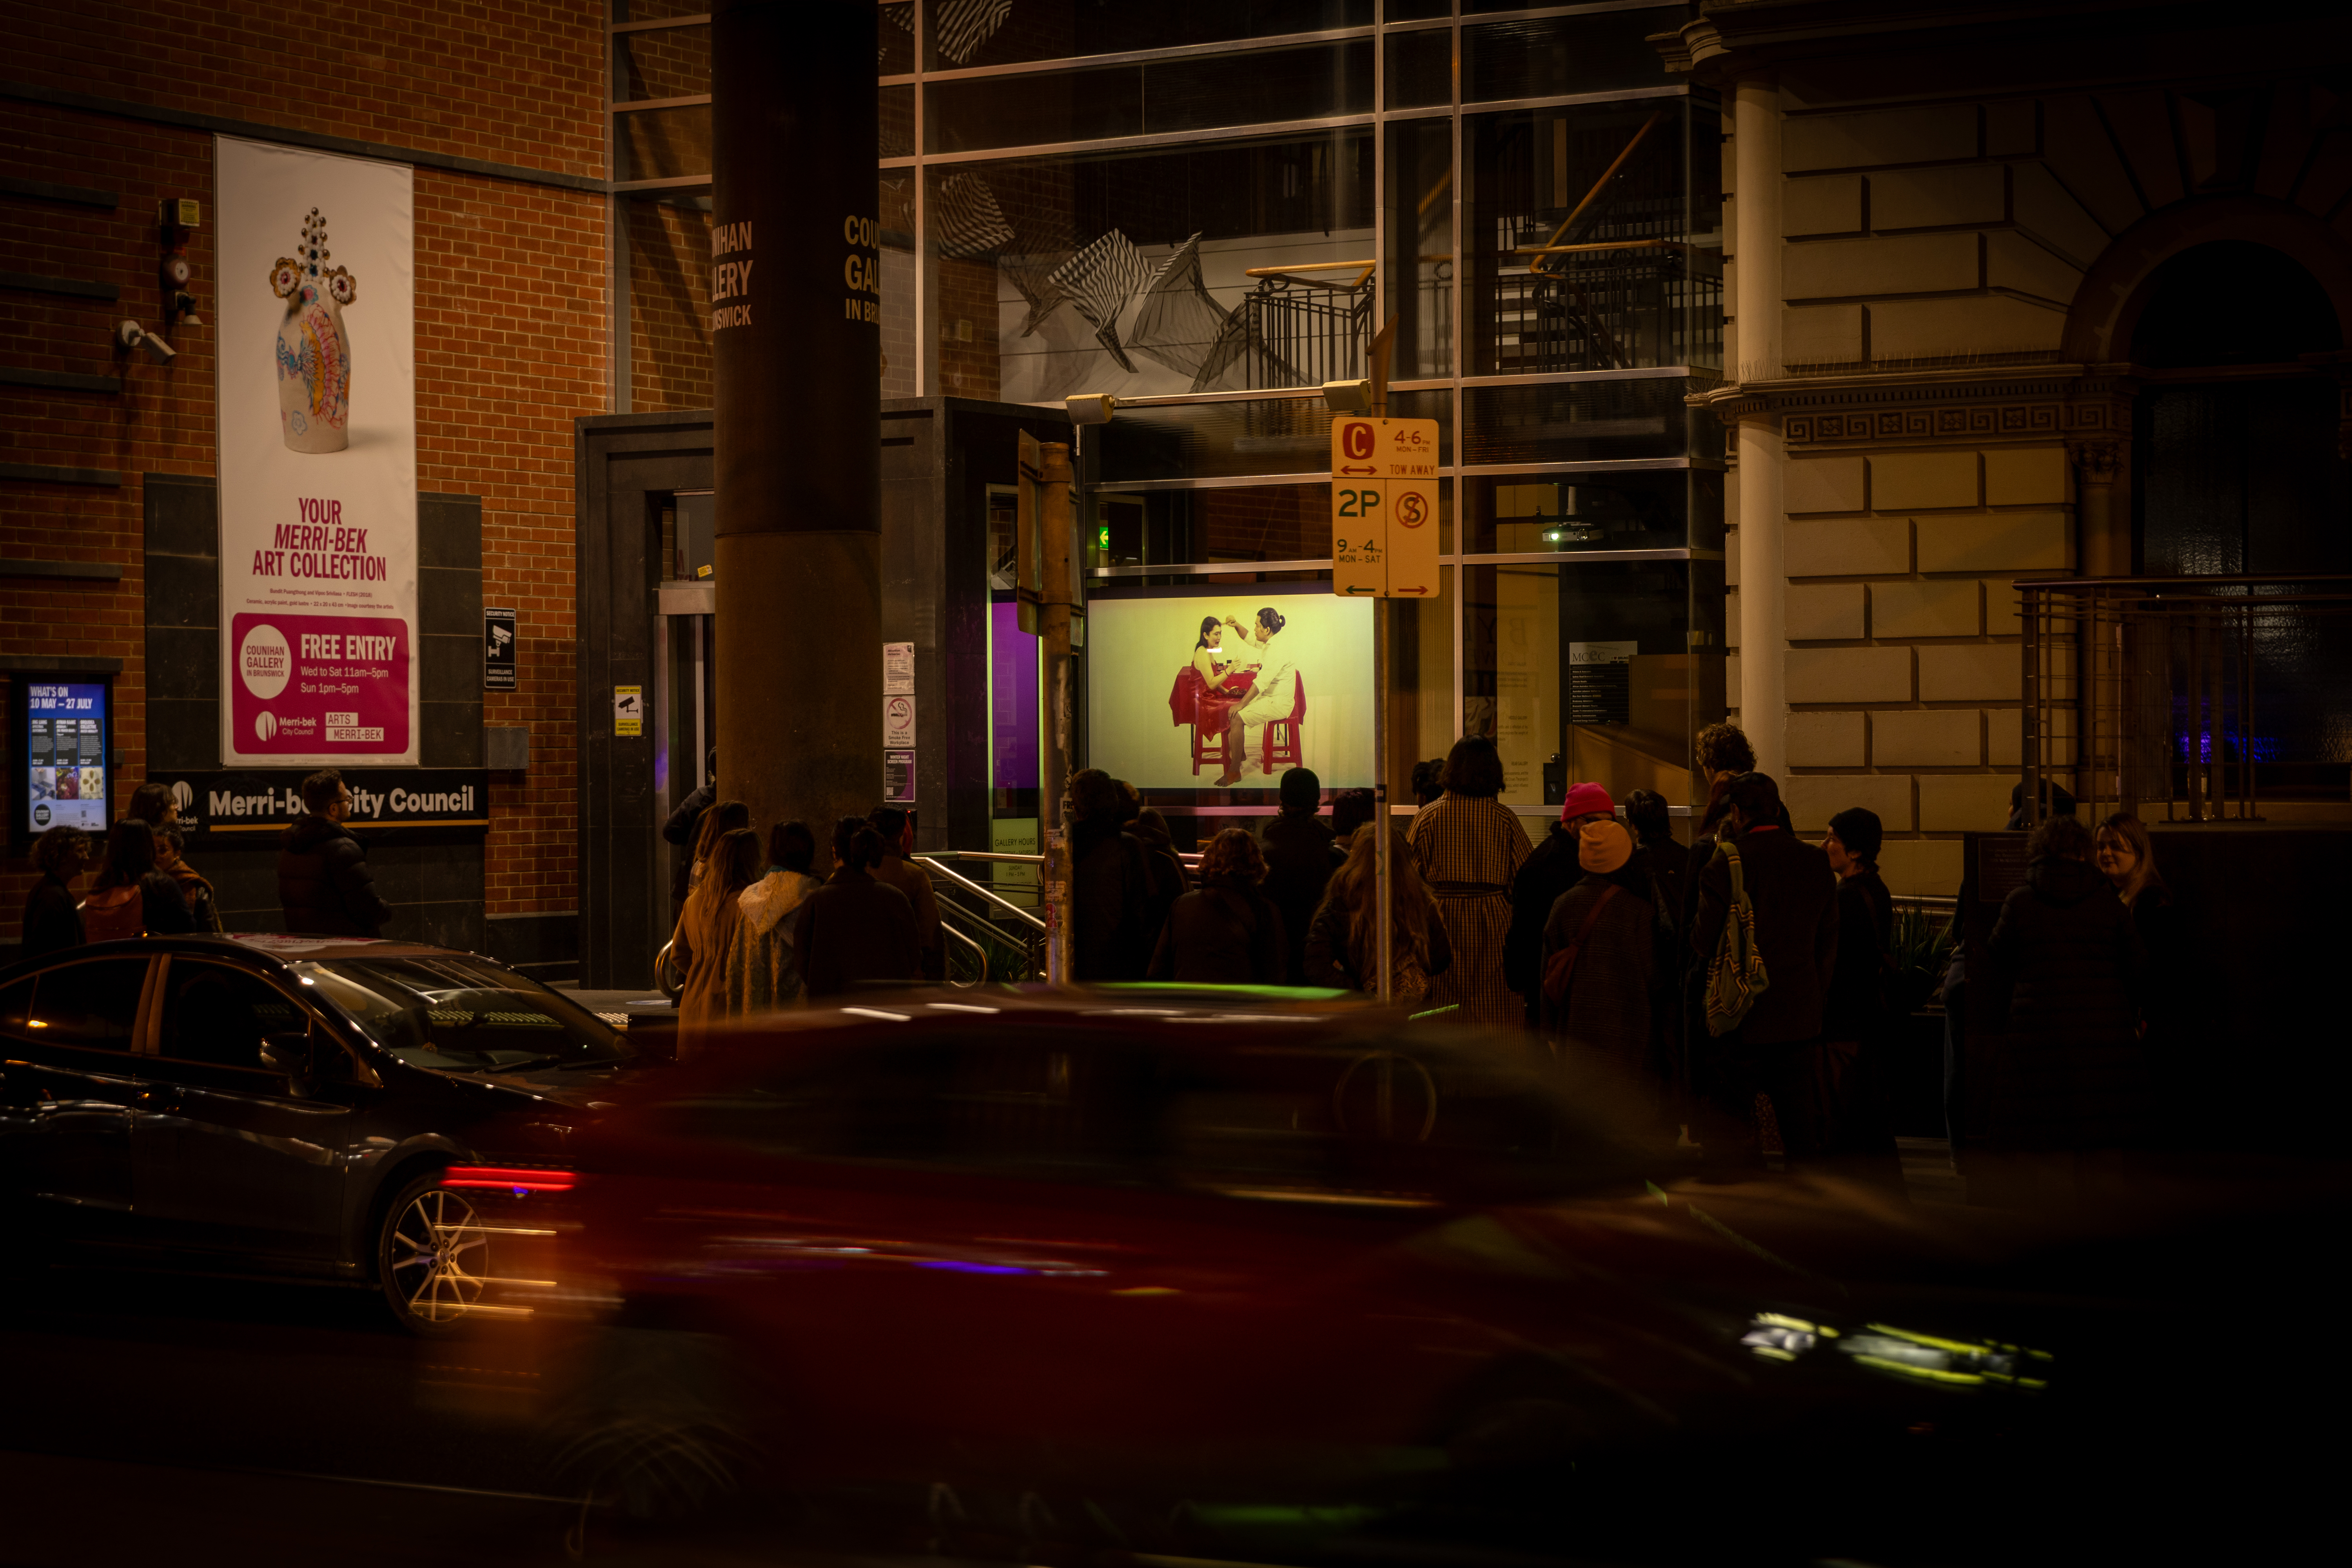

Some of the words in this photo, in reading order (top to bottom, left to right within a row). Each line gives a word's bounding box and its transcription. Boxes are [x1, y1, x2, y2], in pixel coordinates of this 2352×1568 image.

[844, 254, 880, 295] GAL
[846, 298, 861, 320] IN
[864, 301, 880, 325] BRU
[1351, 426, 1366, 456] C
[1390, 465, 1407, 475] TOW
[1410, 465, 1435, 475] AWAY
[1339, 489, 1381, 517] 2P
[299, 498, 341, 524] YOUR
[274, 524, 368, 553] MERRI-BEK
[253, 550, 285, 576] ART
[290, 552, 386, 581] COLLECTION
[247, 645, 285, 656] COUNIHAN
[301, 633, 341, 659] FREE
[346, 635, 396, 661] ENTRY
[247, 657, 284, 668] GALLERY
[300, 666, 318, 676] Wed
[320, 668, 328, 677] to
[329, 667, 343, 677] Sat
[30, 686, 56, 697] WHAT'S
[58, 686, 68, 697] ON
[301, 682, 316, 693] Sun
[30, 698, 40, 708] 10
[41, 698, 57, 708] MAY
[66, 698, 75, 709] 27
[76, 698, 93, 709] JULY
[279, 717, 316, 727] Merri-bek
[328, 715, 350, 724] ARTS
[334, 729, 381, 740] MERRI-BEK
[209, 787, 310, 816] Merri-b
[390, 785, 474, 814] Council
